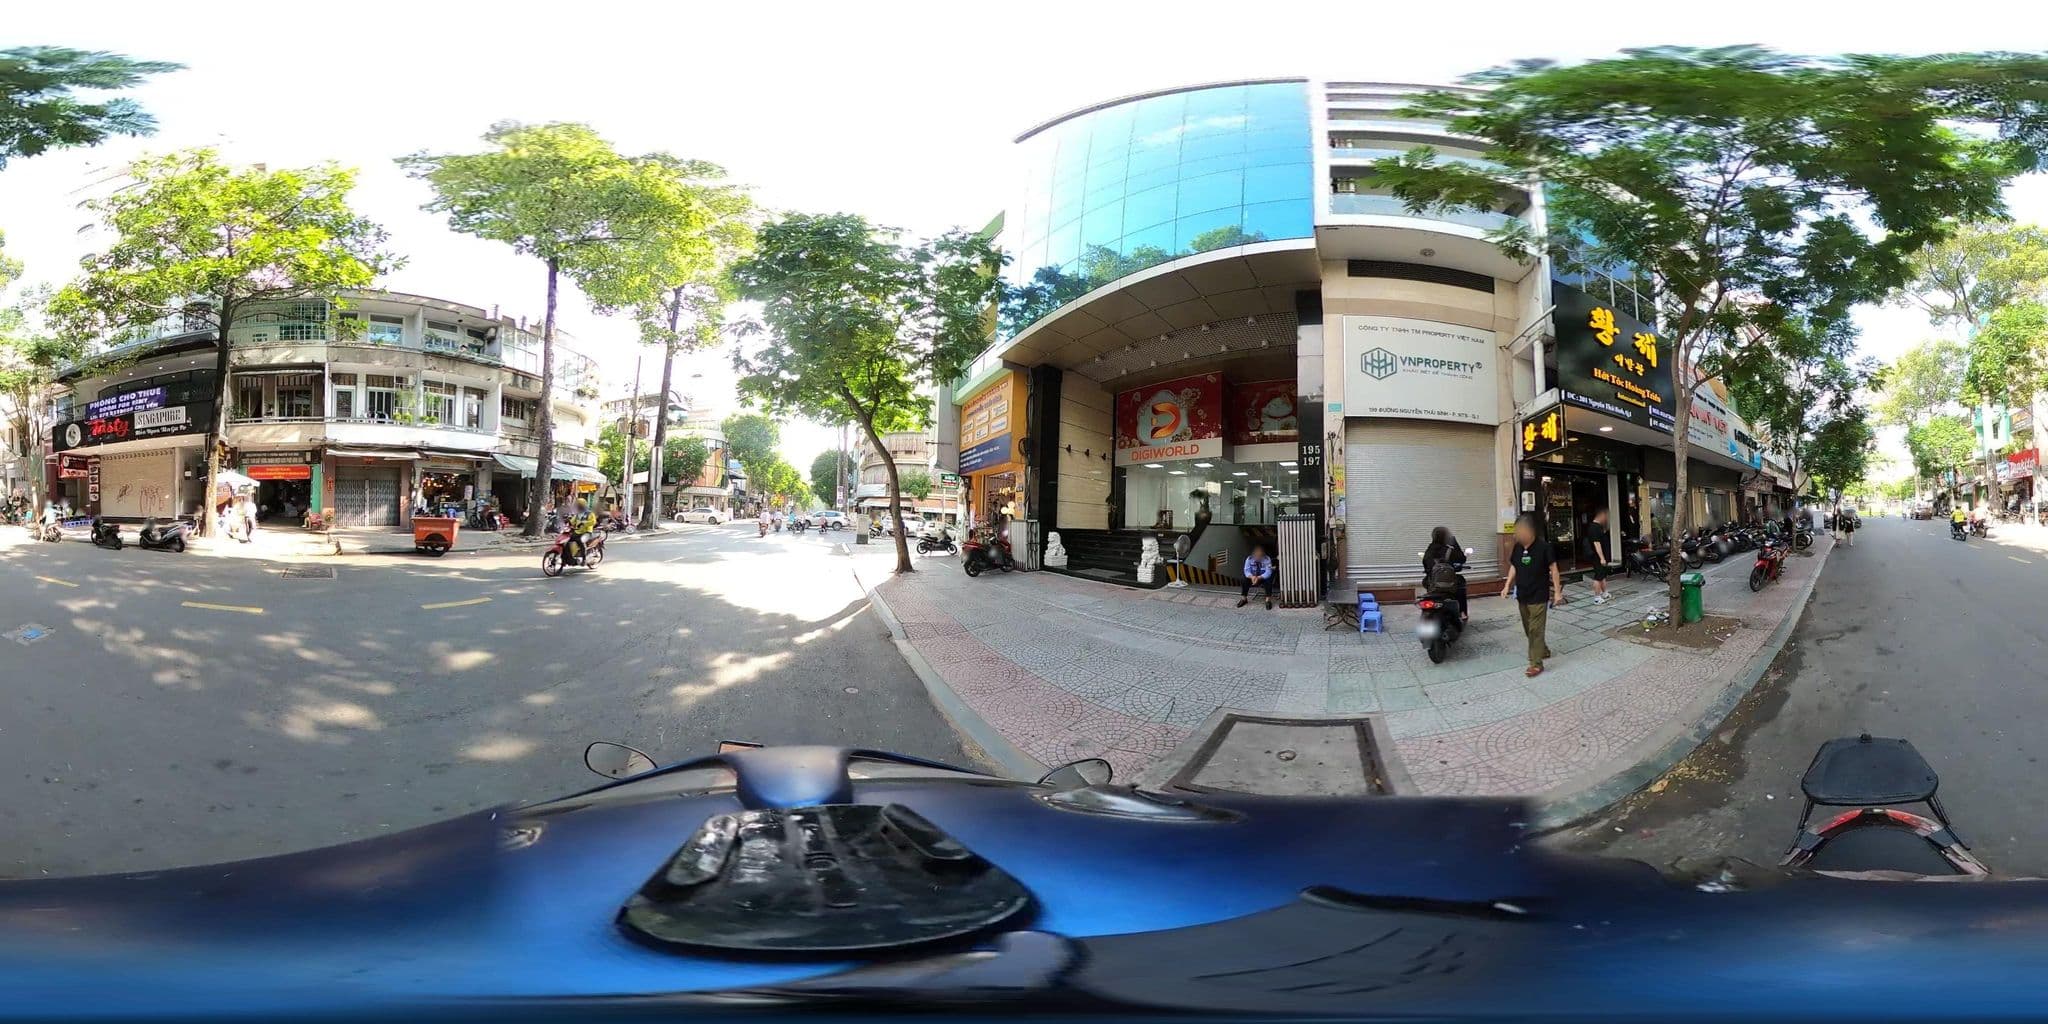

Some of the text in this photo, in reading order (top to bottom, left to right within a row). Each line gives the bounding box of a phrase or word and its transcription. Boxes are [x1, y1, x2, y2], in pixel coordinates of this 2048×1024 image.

[1421, 330, 1455, 340] PROPERTY
[119, 392, 136, 402] CHO
[137, 410, 182, 426] SINGAPORE
[88, 417, 129, 438] Tasty
[1131, 444, 1199, 461] DIGIWORLD
[1302, 445, 1320, 455] 195
[1302, 456, 1320, 466] 197
